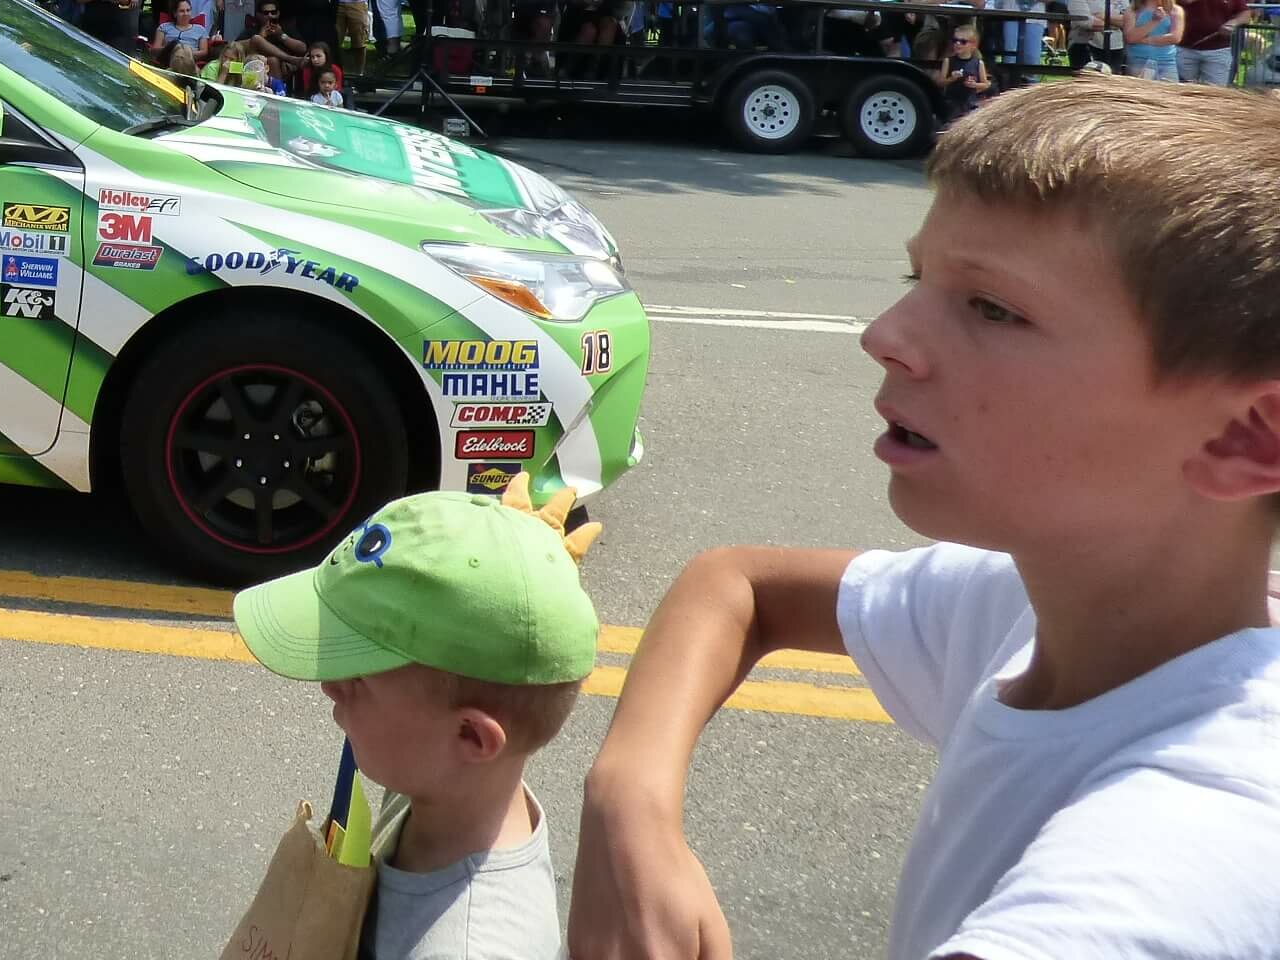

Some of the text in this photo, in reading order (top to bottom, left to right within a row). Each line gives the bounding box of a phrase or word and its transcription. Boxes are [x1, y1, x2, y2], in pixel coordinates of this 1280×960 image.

[101, 190, 178, 213] Holley EFI
[44, 223, 67, 231] WEAR
[99, 213, 152, 242] 3M
[101, 246, 157, 261] Duralast
[20, 270, 54, 279] WILLIAMS
[21, 262, 53, 272] SHERWIN
[185, 249, 360, 293] GOODYEAR
[424, 341, 537, 364] MOOG
[584, 332, 611, 372] 18
[442, 373, 538, 396] MAHLE
[458, 406, 528, 422] COMP
[463, 436, 528, 452] Edelbrock
